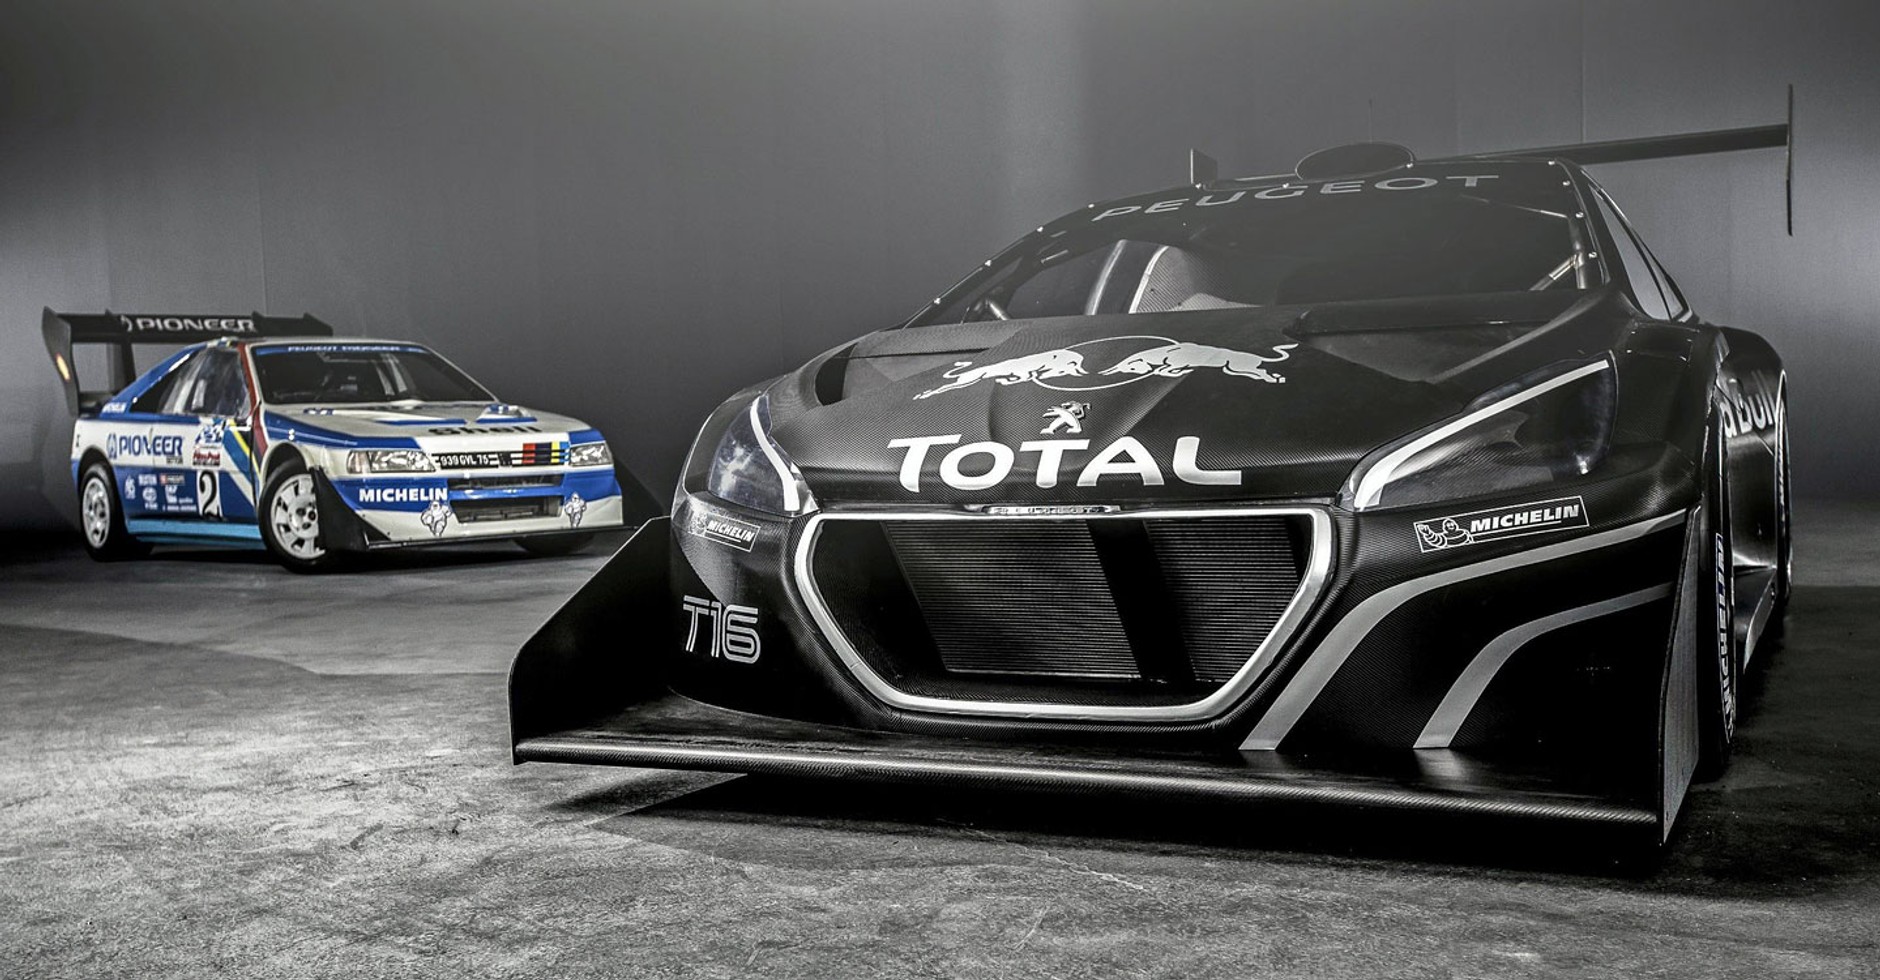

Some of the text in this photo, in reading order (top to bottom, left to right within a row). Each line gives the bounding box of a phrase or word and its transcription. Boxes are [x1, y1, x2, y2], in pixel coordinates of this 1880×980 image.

[1091, 174, 1500, 223] PEUGEOT
[136, 318, 256, 332] PIONEER
[428, 426, 542, 435] Shell
[118, 435, 183, 456] PIONEER
[886, 433, 1242, 493] TOTAL
[199, 471, 220, 518] 2
[358, 487, 448, 502] MICHELIN
[706, 519, 755, 542] MICHELIN
[1470, 505, 1579, 532] MICHELIN
[682, 594, 761, 664] T16
